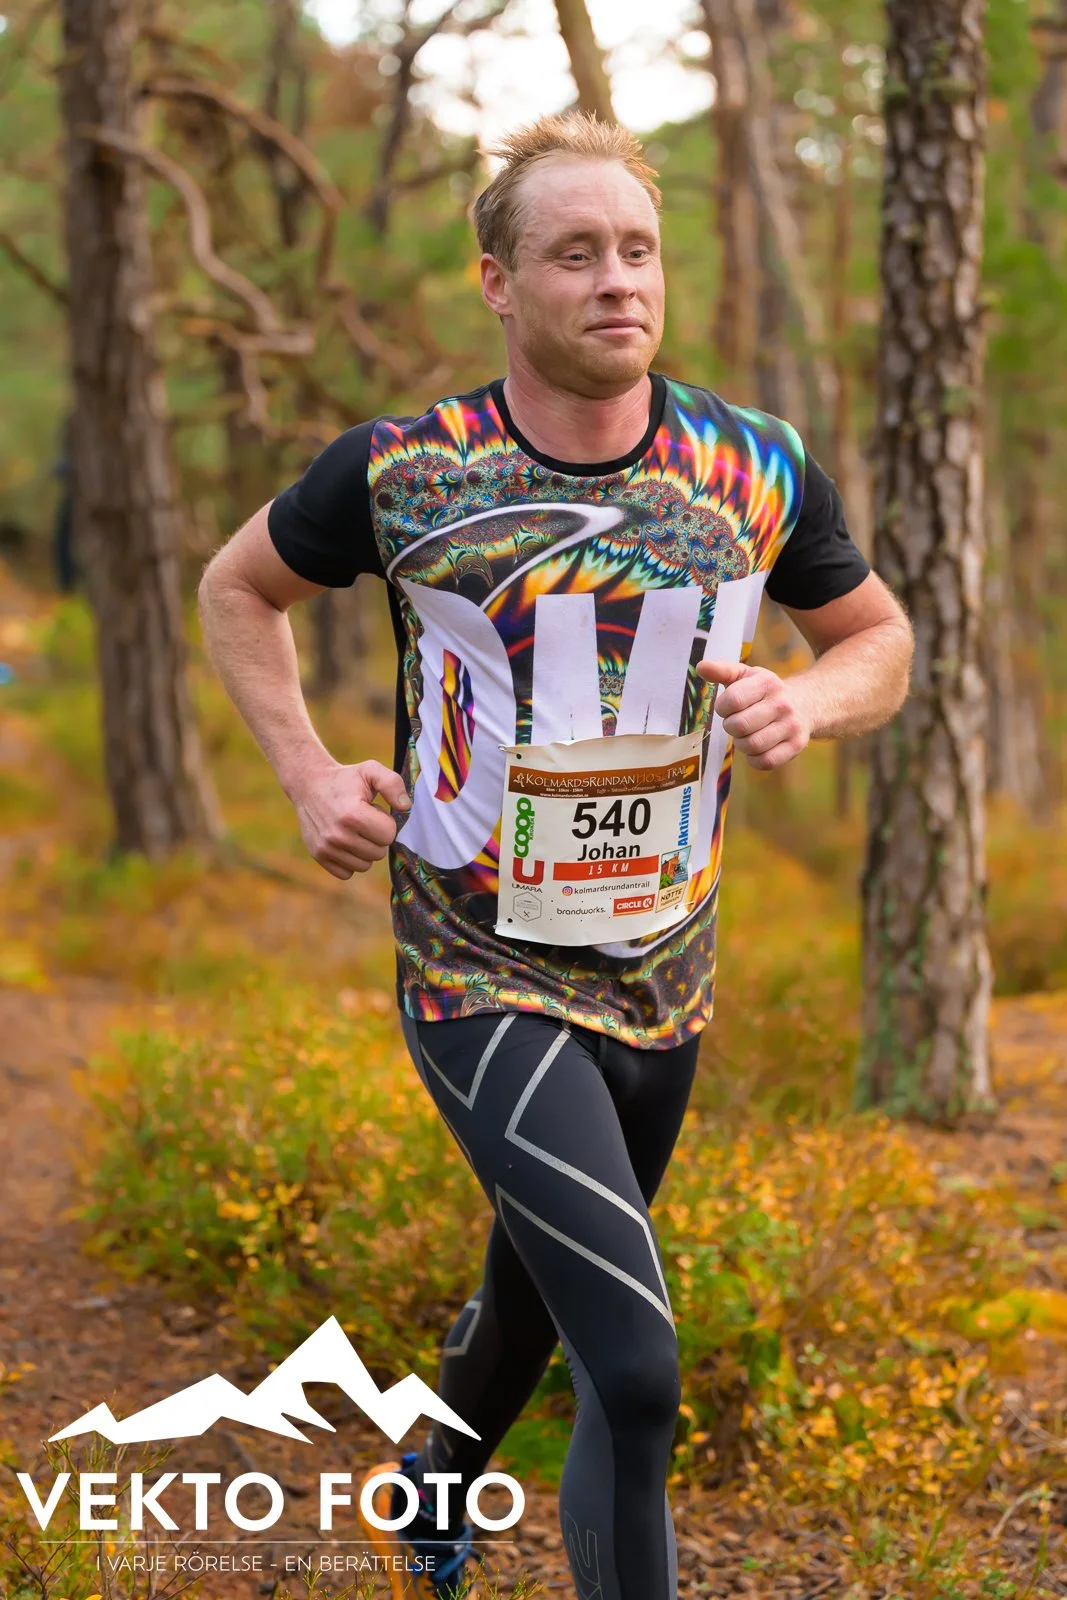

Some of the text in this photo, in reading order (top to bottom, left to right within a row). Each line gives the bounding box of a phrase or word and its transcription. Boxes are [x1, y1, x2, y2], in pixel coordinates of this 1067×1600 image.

[572, 798, 652, 840] 540
[677, 785, 692, 847] Aktivitus
[514, 797, 535, 858] coop
[577, 842, 641, 861] Johan
[588, 863, 629, 876] 15 KM
[511, 883, 543, 894] UMARA
[574, 881, 650, 895] kolmardsrundantrail
[616, 900, 642, 910] CIRCLE
